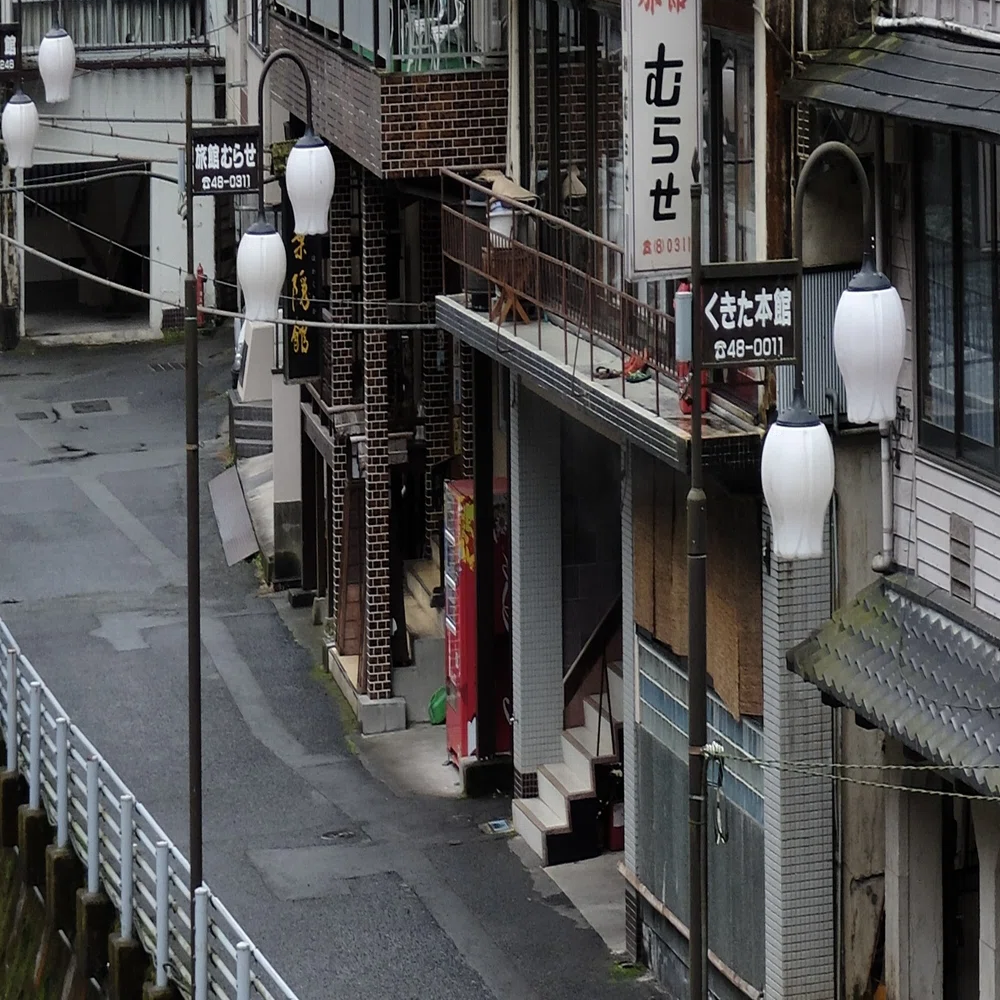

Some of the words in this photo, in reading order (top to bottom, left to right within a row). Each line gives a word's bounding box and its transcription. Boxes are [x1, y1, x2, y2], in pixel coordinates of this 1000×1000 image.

[645, 43, 684, 221] むらせ
[195, 142, 256, 170] 旅館むらせ
[210, 174, 251, 189] 48-0311
[704, 286, 792, 333] くきた本館
[727, 336, 784, 359] 48-0011
